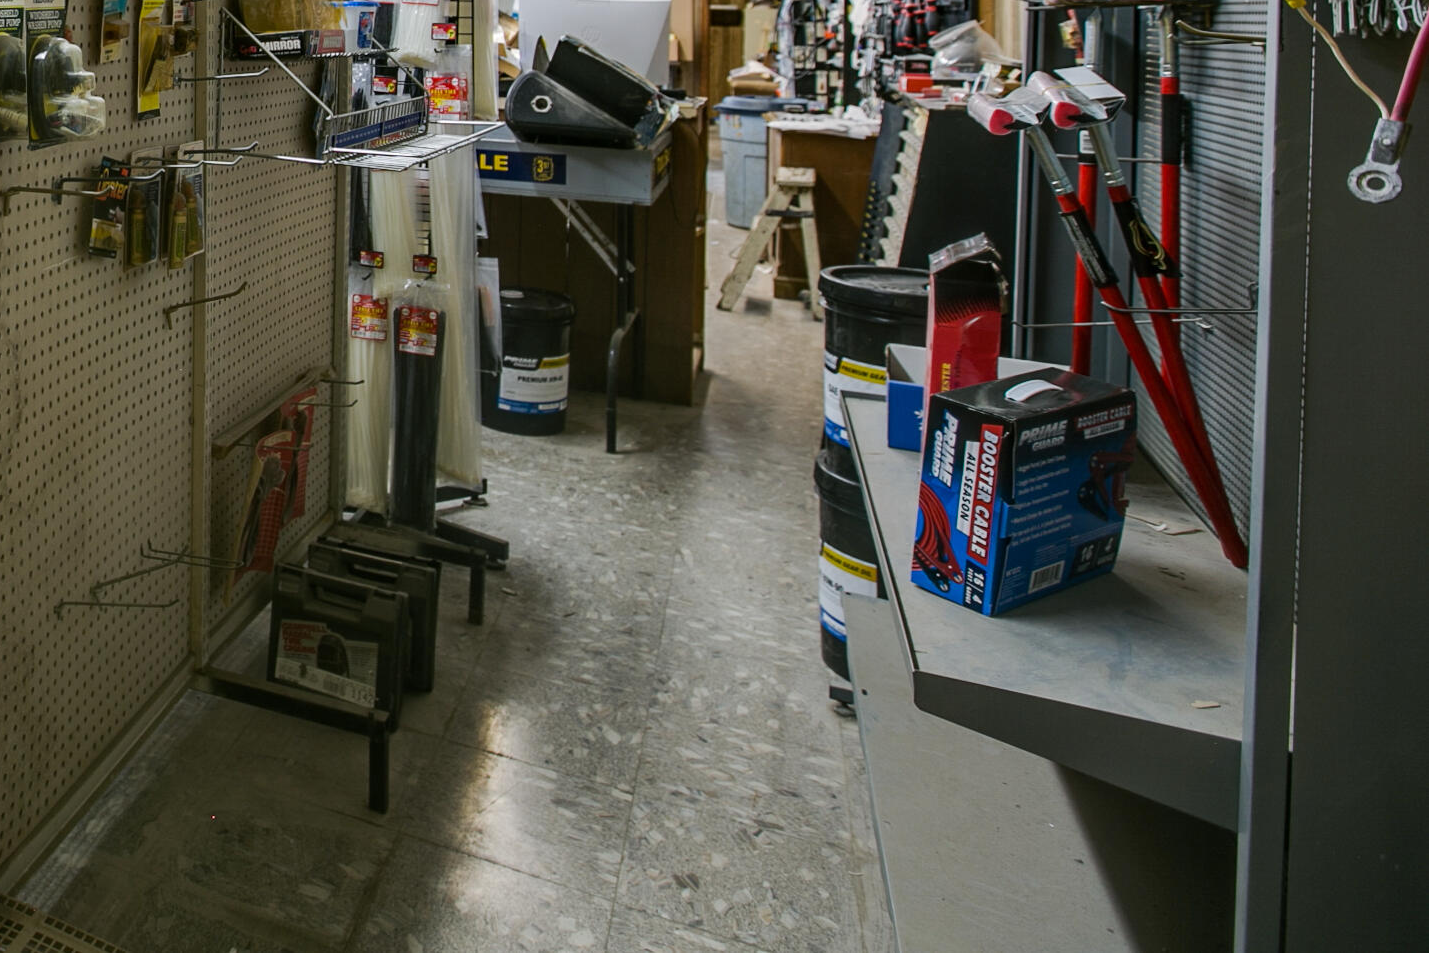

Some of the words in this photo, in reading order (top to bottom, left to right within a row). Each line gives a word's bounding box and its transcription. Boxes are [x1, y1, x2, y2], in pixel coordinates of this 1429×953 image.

[1018, 419, 1069, 446] PRIME
[1076, 411, 1108, 429] BOOSTER
[1110, 404, 1132, 419] CABLE
[931, 429, 943, 478] GUARD
[938, 409, 959, 487] PRIME
[966, 452, 977, 475] ALL
[976, 429, 998, 504] BOOSTER
[1032, 435, 1066, 452] GUARD
[960, 475, 974, 522] SEASON
[971, 504, 990, 559] CABLE
